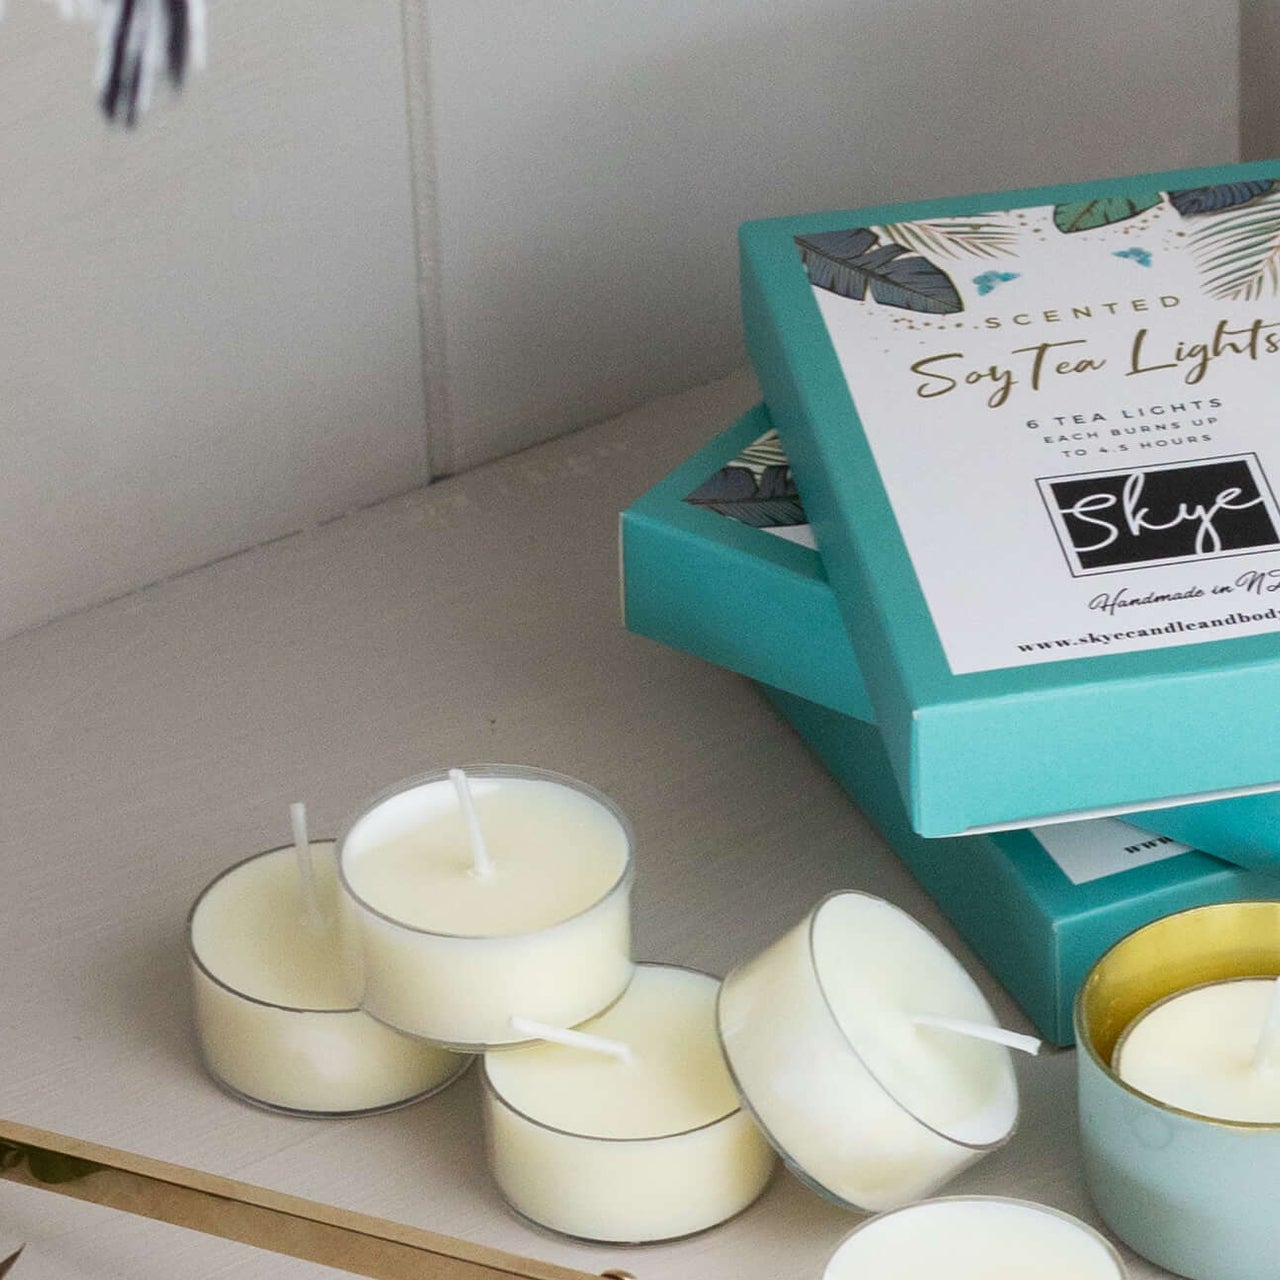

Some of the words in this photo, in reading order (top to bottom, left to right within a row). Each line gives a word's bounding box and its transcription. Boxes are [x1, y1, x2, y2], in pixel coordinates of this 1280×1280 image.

[984, 294, 1181, 330] SCENTED
[1026, 419, 1040, 430] 6
[1053, 412, 1107, 427] TEA
[1121, 398, 1223, 420] LIGHTS
[1043, 431, 1100, 445] EACH
[1110, 421, 1182, 438] BURNS
[1191, 417, 1220, 428] UP
[1060, 448, 1088, 459] TO
[1098, 443, 1129, 454] 4.5
[1139, 434, 1213, 450] HOURS
[1060, 472, 1265, 557] Skye
[1087, 586, 1205, 616] Handmade
[1210, 584, 1234, 596] in
